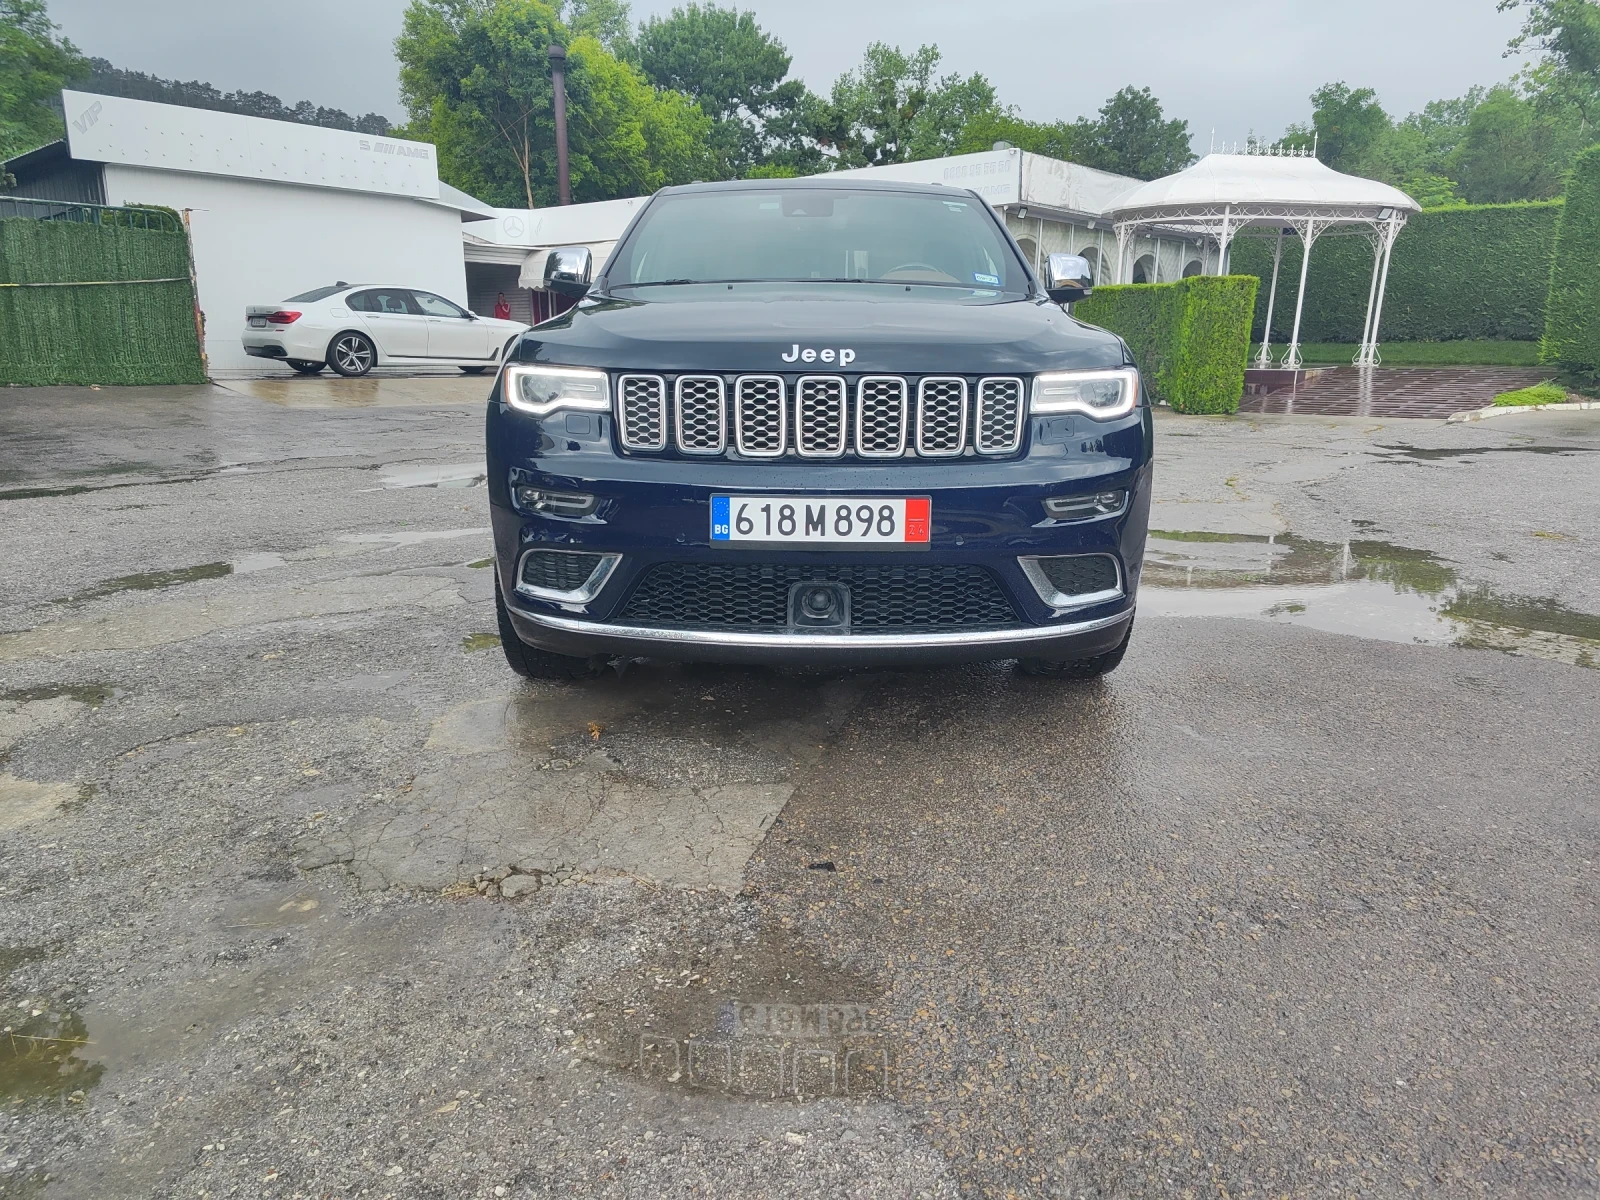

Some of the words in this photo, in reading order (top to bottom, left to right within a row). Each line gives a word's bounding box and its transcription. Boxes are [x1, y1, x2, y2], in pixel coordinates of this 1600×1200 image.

[72, 101, 102, 134] VIP
[359, 140, 371, 151] S
[781, 344, 856, 367] Jeep
[714, 524, 729, 535] BG
